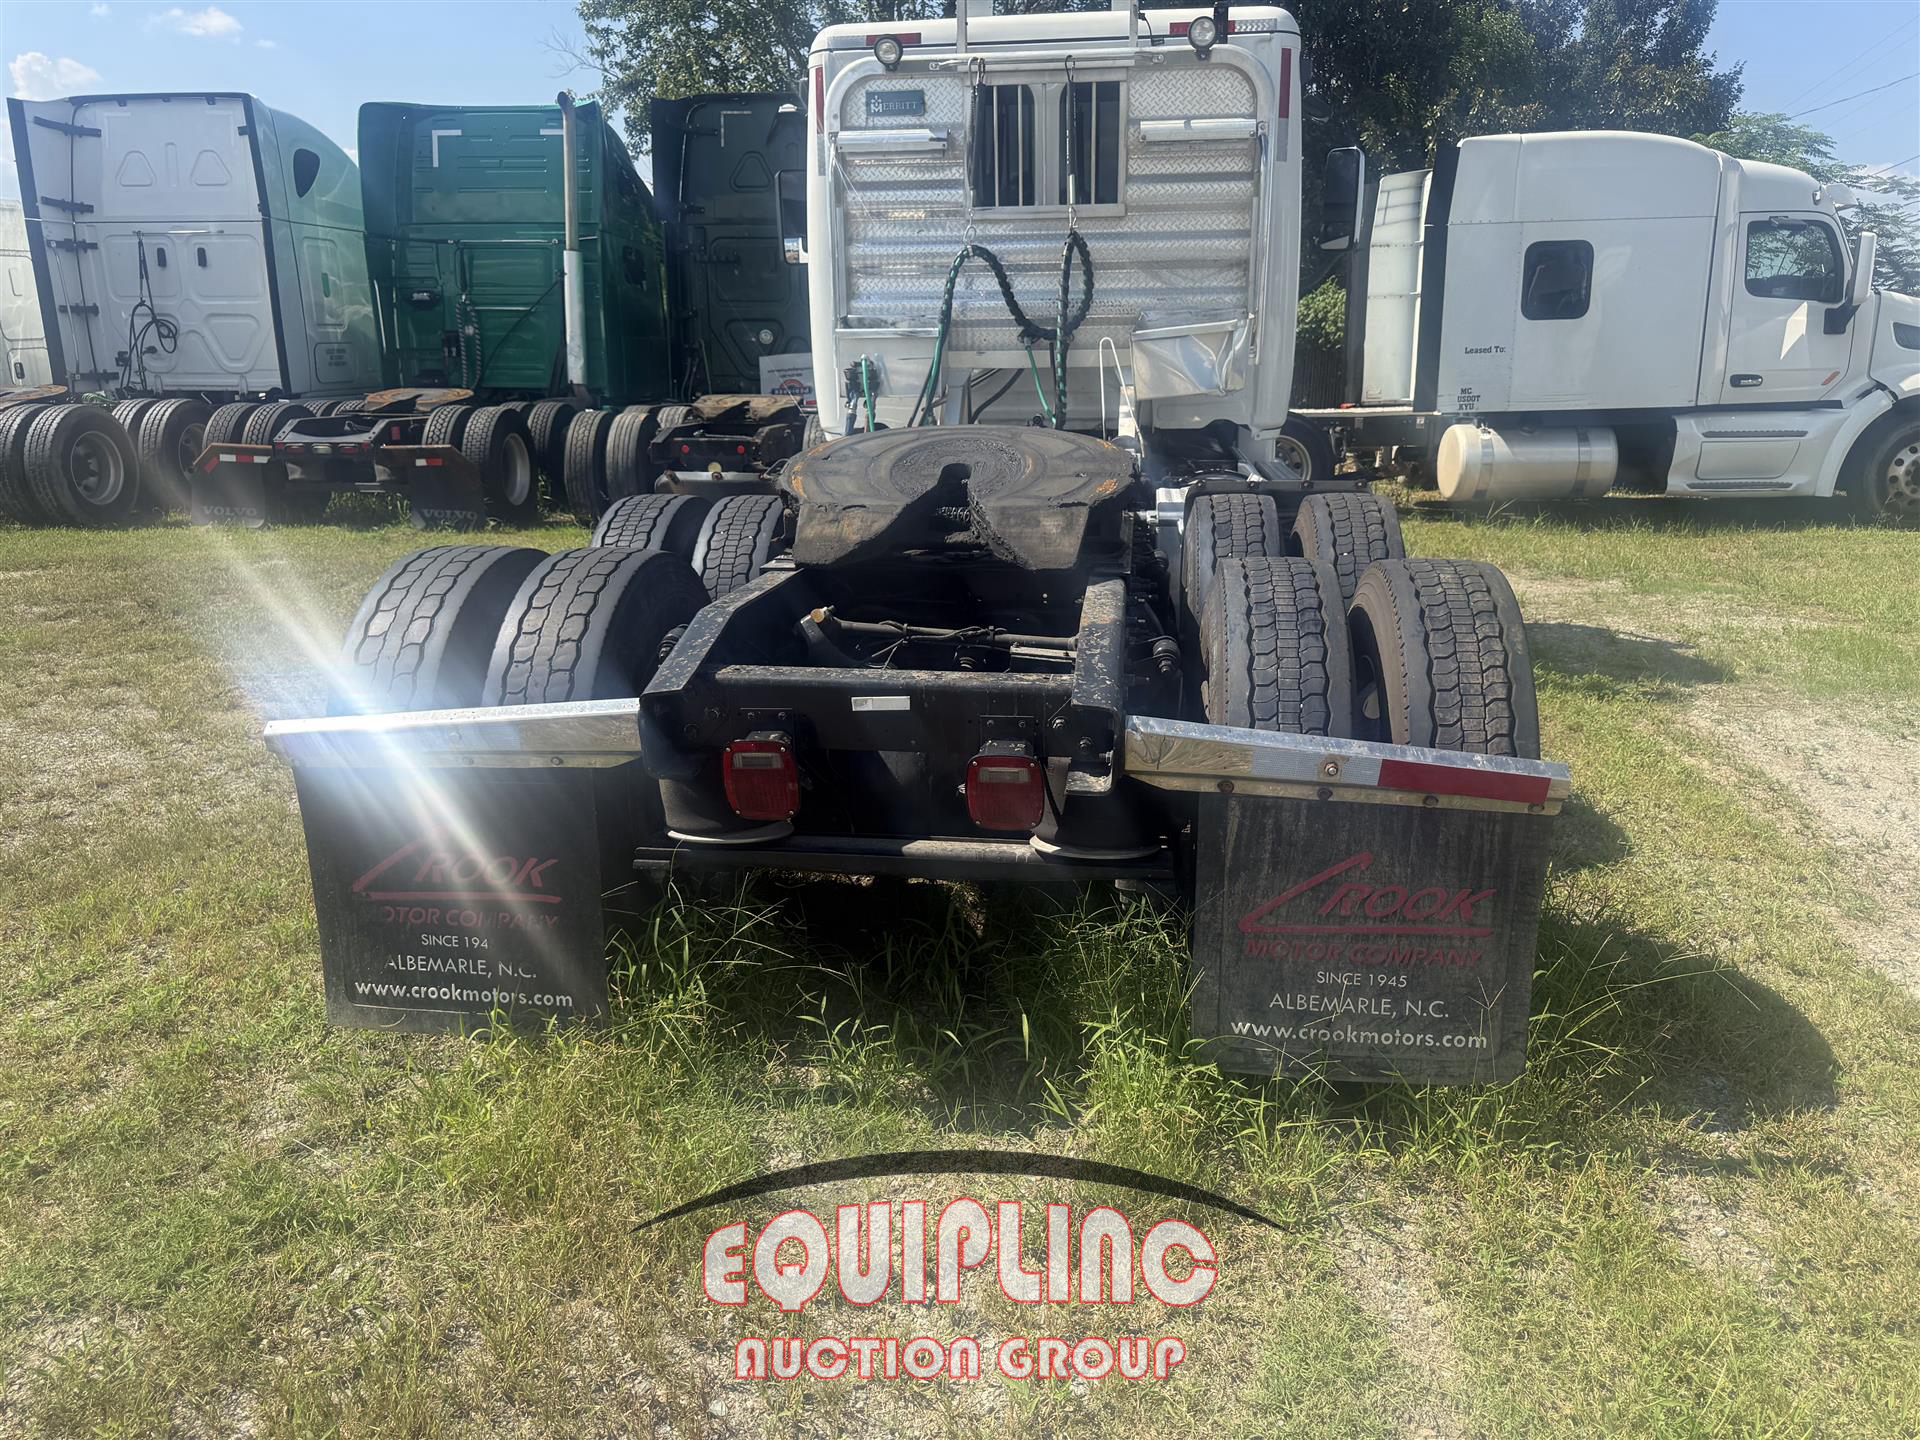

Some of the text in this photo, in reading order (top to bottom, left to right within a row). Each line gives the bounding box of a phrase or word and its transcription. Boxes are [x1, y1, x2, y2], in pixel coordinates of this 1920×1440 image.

[870, 101, 917, 113] MERRITT
[1464, 345, 1506, 354] Leased To:
[1460, 387, 1472, 395] MC
[1458, 403, 1475, 411] KYU
[202, 505, 257, 516] VOLVO
[421, 509, 478, 520] VOLVO
[1238, 852, 1498, 938] CROOK
[382, 906, 441, 926] OTOR
[421, 933, 489, 950] SINCE 194
[1244, 940, 1484, 967] MOTOR COMPANY
[384, 954, 493, 979] ALBEMARLE,
[1316, 971, 1408, 988] SINCE 1945
[355, 981, 573, 1008] www.crookmotors.com
[1269, 993, 1449, 1019] ALBEMARLE, N.C.
[1231, 1021, 1487, 1049] www.crookmotors.com
